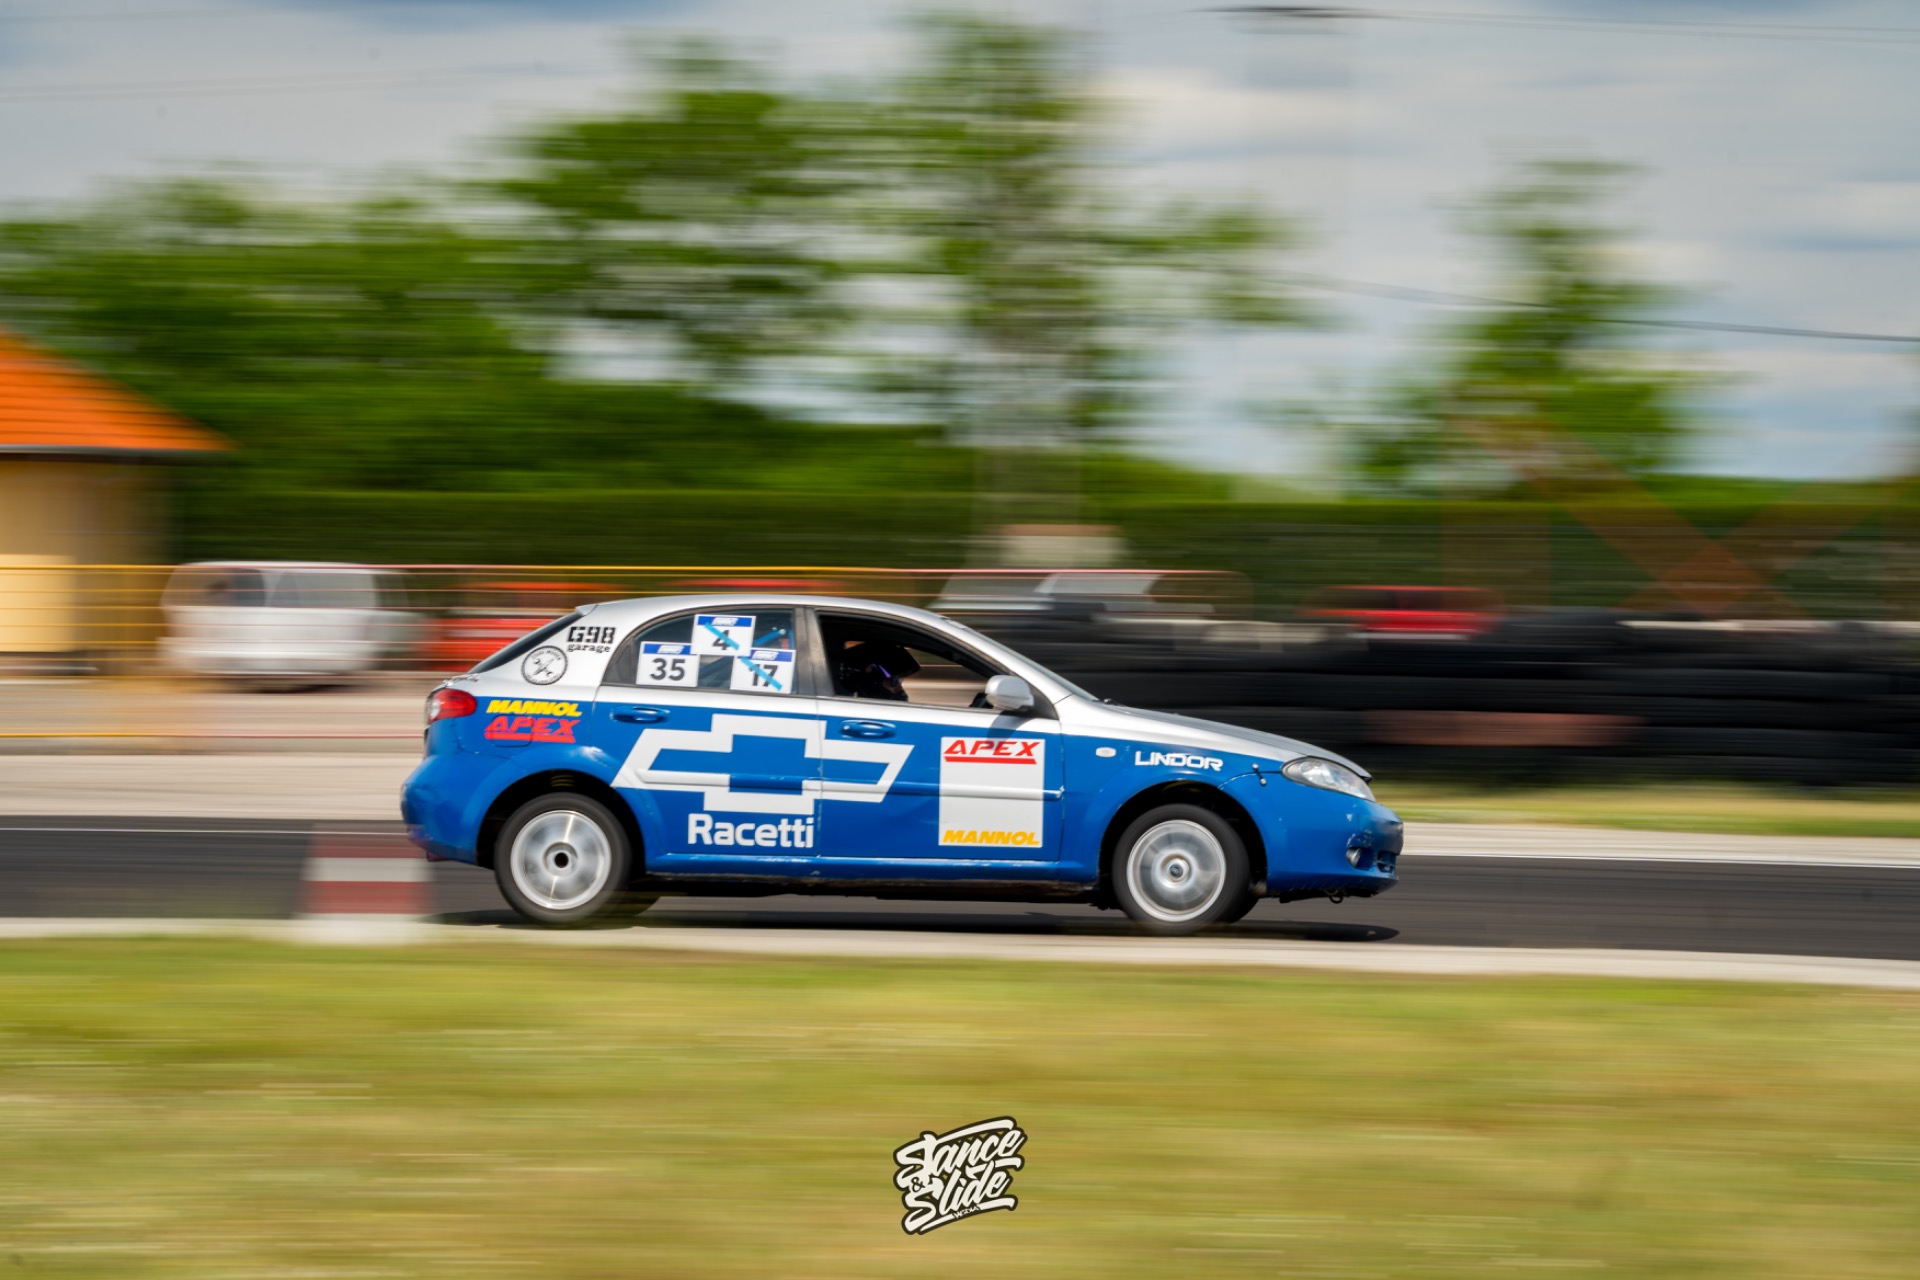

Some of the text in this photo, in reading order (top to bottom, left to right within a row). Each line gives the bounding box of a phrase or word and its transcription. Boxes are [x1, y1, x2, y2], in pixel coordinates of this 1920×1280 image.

[567, 626, 617, 644] G98
[712, 629, 732, 651] 4
[567, 643, 611, 653] garage
[650, 657, 686, 682] 35
[748, 663, 779, 688] 17
[486, 699, 583, 717] MANNOL
[485, 716, 581, 736] APEX
[943, 739, 1041, 758] APEX
[1134, 750, 1223, 771] LINDOR
[687, 812, 815, 849] Racetti
[942, 829, 1040, 846] MANNOL
